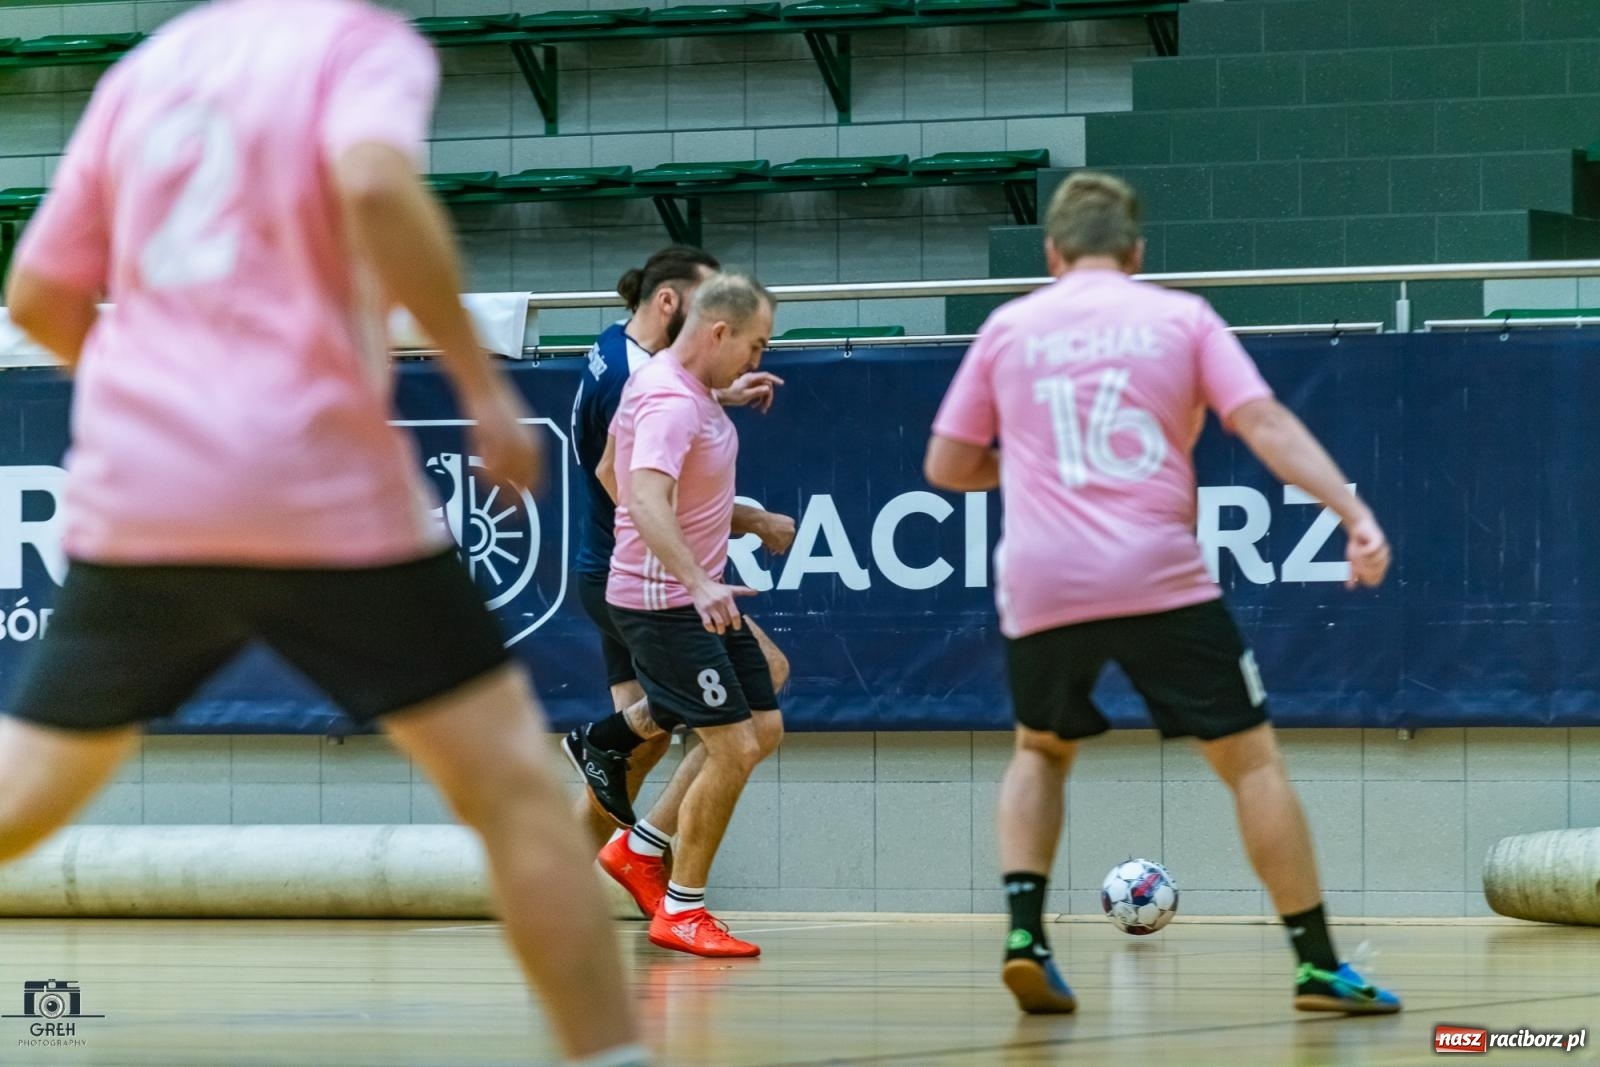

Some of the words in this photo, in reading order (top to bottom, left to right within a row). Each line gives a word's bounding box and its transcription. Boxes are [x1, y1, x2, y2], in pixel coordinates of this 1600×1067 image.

[141, 102, 235, 286] 2
[1034, 368, 1168, 487] 16
[727, 483, 1356, 592] ACIRZ
[697, 668, 727, 707] 8
